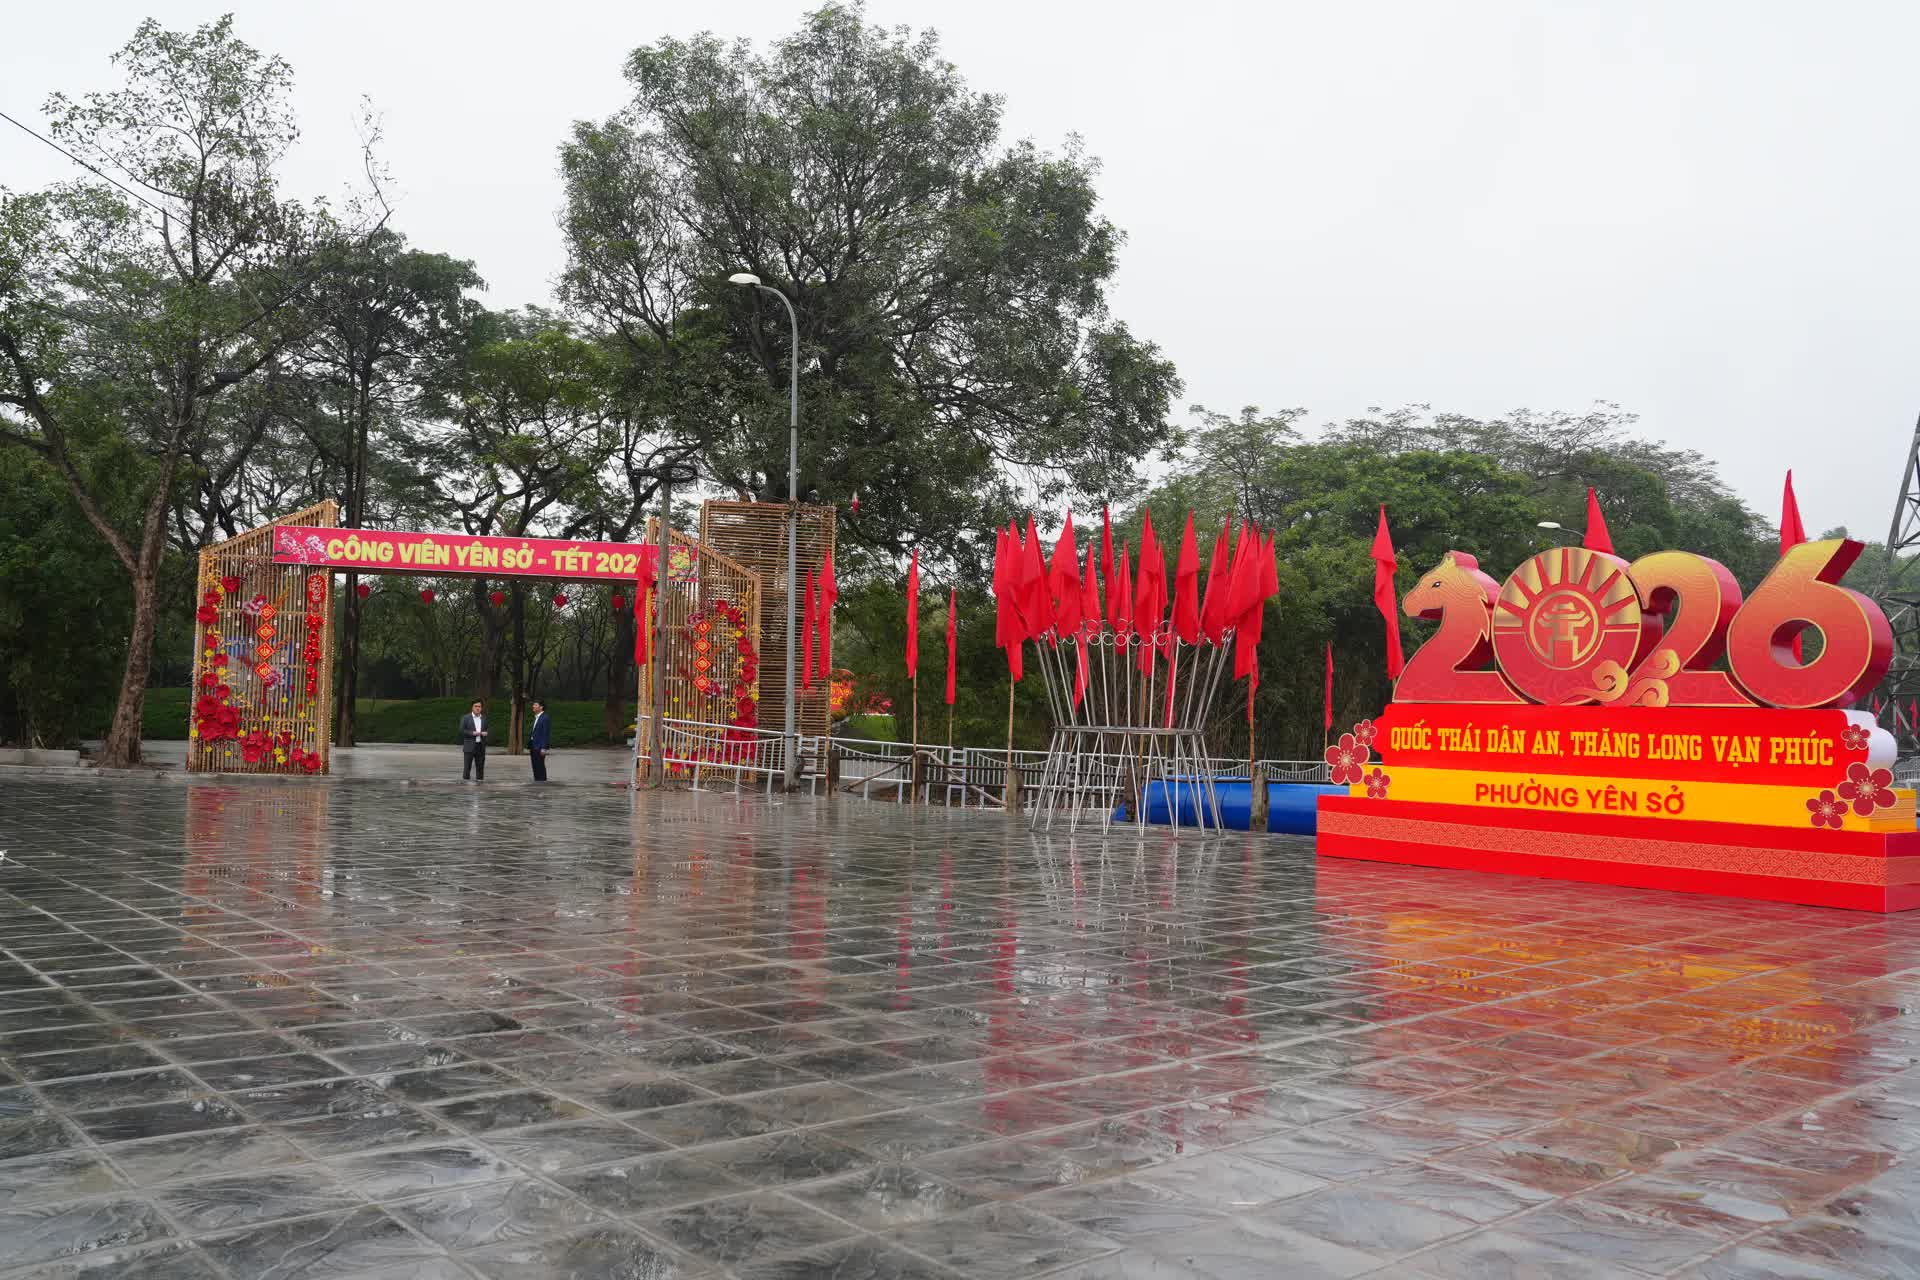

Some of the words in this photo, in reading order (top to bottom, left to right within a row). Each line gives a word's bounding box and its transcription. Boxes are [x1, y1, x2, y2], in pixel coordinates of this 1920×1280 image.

[327, 535, 394, 562] CÔNG
[398, 538, 449, 566] VIÊN
[454, 541, 498, 568] YÊN
[501, 543, 535, 569] SỞ
[551, 546, 593, 572] TẾT
[595, 552, 641, 574] 202
[1391, 719, 1432, 752] QUỐC
[1437, 722, 1481, 753] THÁI
[1486, 725, 1526, 754] DÂN
[1531, 730, 1564, 758] AN,
[1570, 728, 1640, 759] THĂNG
[1647, 733, 1702, 761] LONG
[1712, 735, 1761, 768] VẠN
[1769, 730, 1833, 766] PHÚC
[1475, 778, 1579, 808] PHƯỜNG
[1587, 784, 1638, 811] YÊN
[1646, 785, 1684, 815] SỞ
